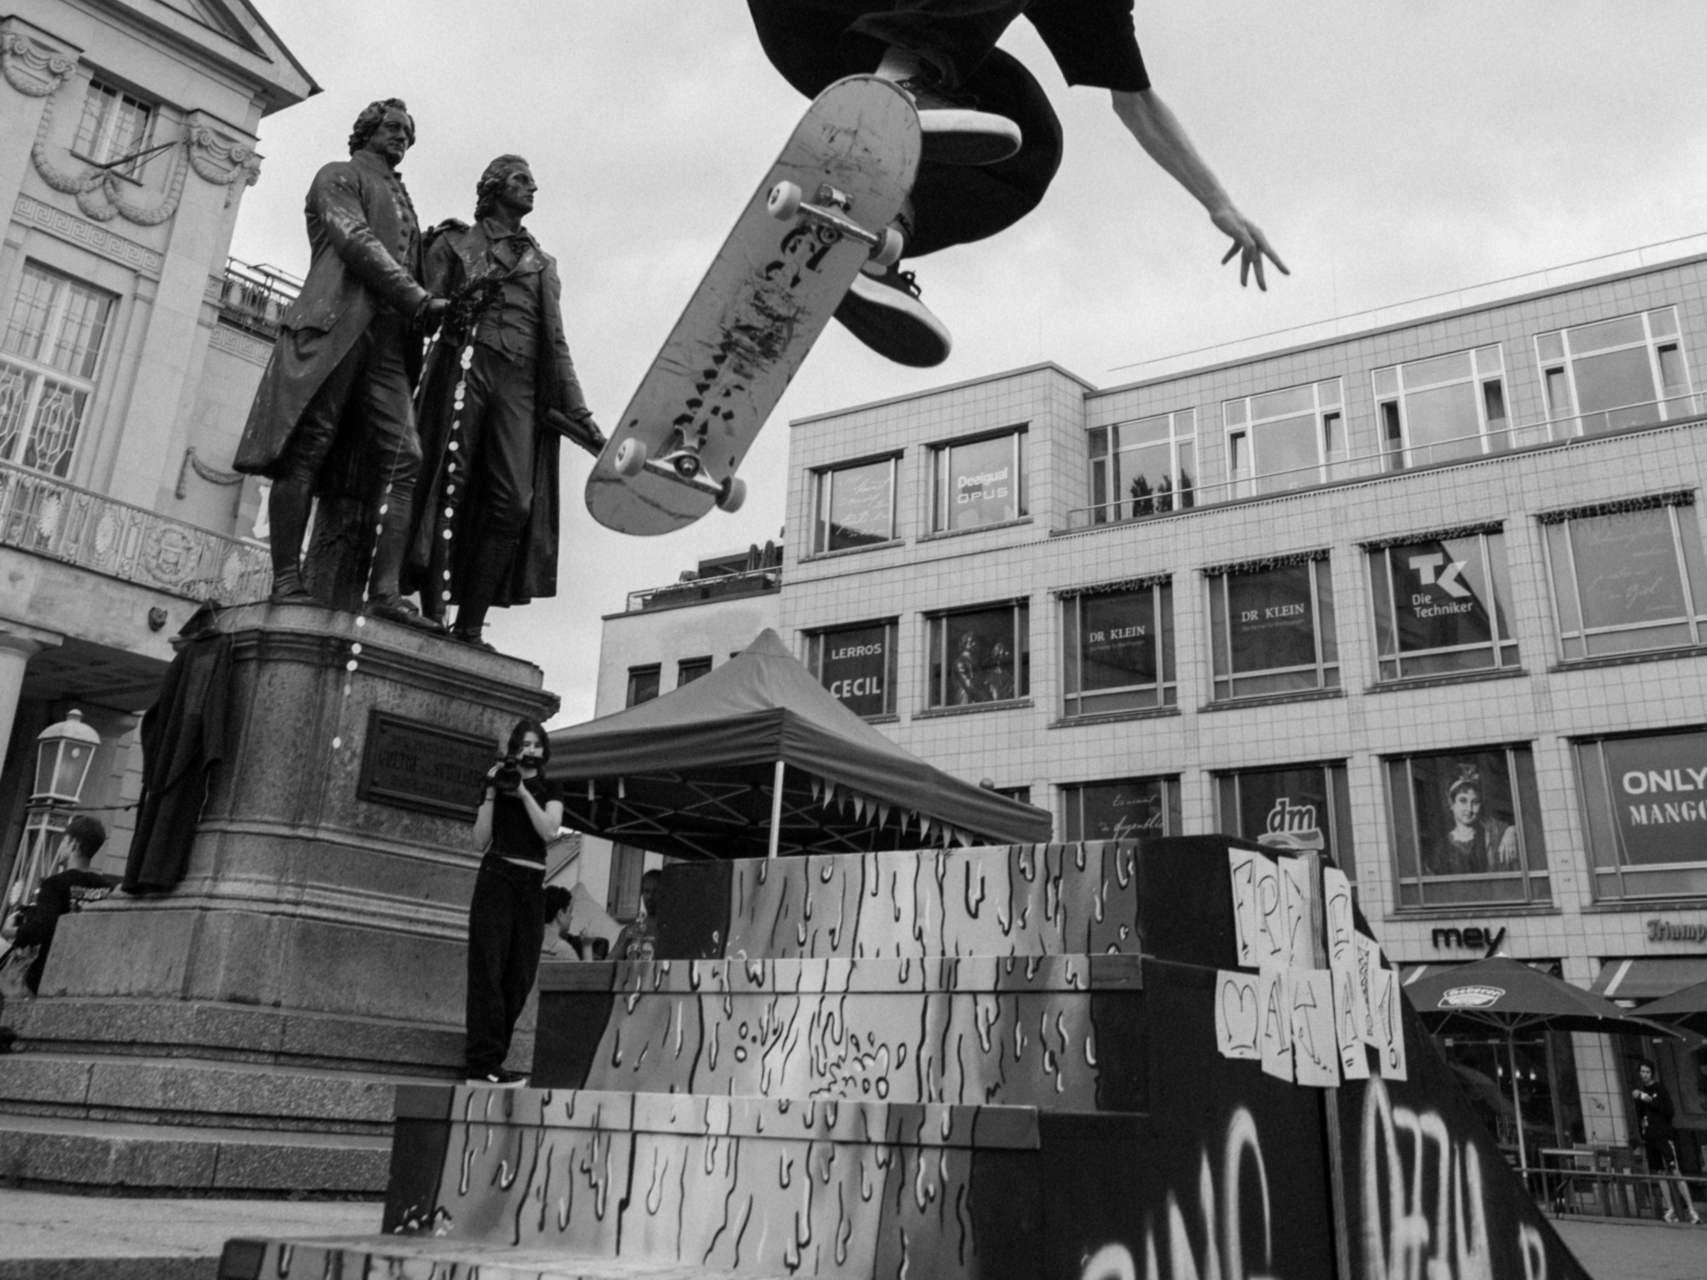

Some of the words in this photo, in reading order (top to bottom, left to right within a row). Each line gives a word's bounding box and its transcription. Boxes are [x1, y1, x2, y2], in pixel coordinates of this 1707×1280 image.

[957, 467, 1008, 489] Desigual
[957, 487, 1008, 505] OPUS
[1411, 593, 1432, 606] Die
[1241, 609, 1259, 623] DR
[1264, 602, 1305, 620] KLEIN
[1413, 602, 1473, 619] Techniker
[1089, 631, 1105, 643] DR
[1110, 624, 1146, 640] KLEIN
[831, 643, 882, 660] LERROS
[830, 677, 881, 699] CECIL
[1622, 766, 1707, 795] ONLY
[1267, 797, 1316, 833] dm
[1646, 919, 1707, 942] Triump
[1432, 926, 1506, 959] mey
